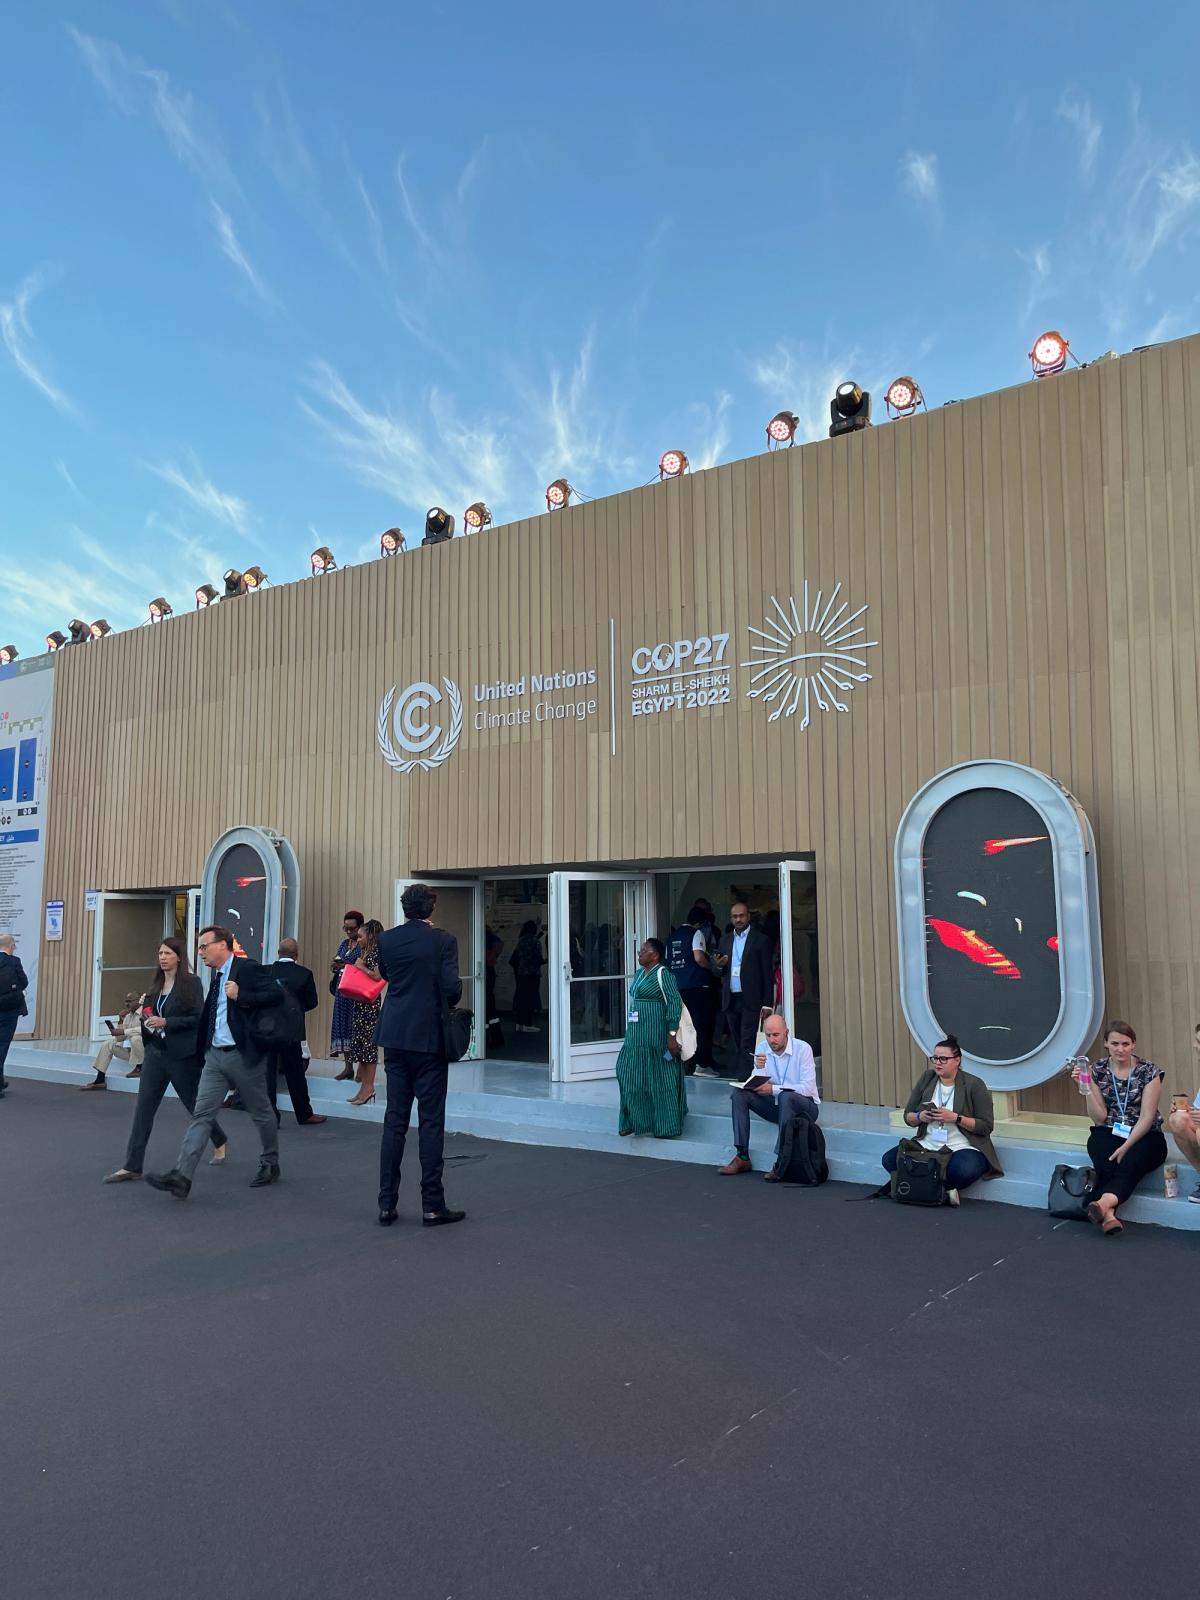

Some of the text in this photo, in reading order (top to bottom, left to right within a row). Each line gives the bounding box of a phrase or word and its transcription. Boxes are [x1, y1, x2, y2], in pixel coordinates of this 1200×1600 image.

[631, 632, 730, 675] COP27
[474, 669, 597, 702] United Nations
[631, 673, 730, 699] SHARM EL-SHEIKH
[474, 699, 597, 730] Climate Change
[631, 687, 731, 717] EGYPT 2022
